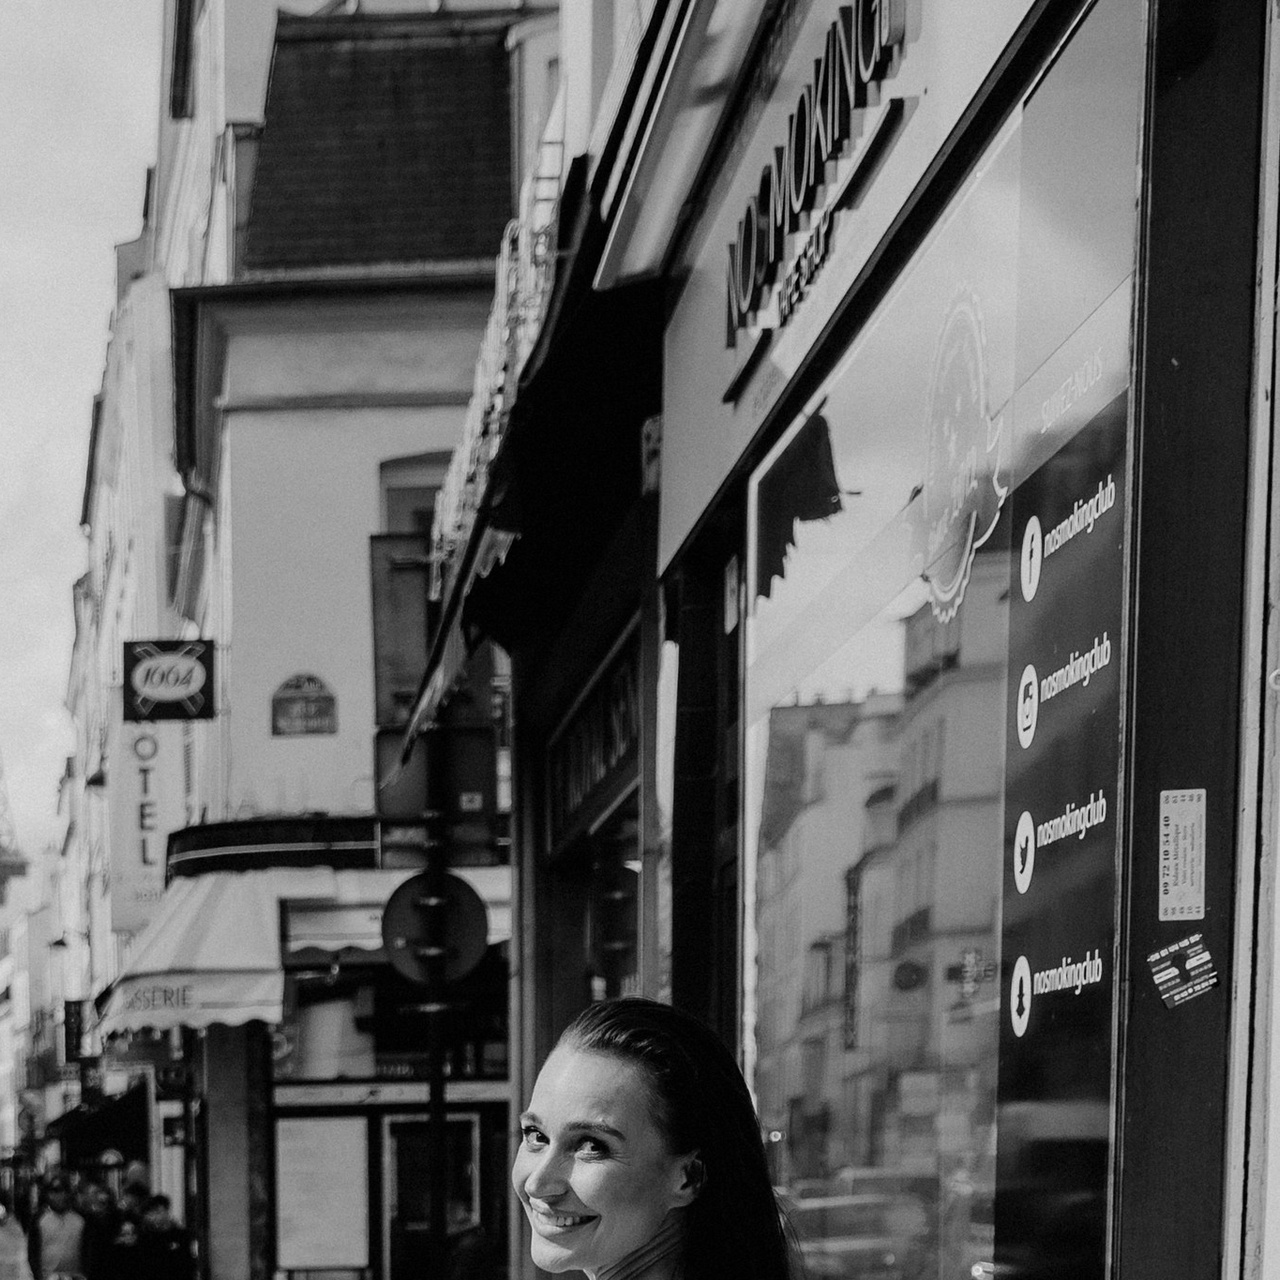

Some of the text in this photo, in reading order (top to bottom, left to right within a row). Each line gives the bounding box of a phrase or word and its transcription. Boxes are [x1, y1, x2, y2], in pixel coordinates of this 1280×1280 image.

[1044, 473, 1116, 558] nosmokingclub
[143, 665, 197, 689] 1664
[1040, 631, 1111, 703] nosmokingclub
[133, 733, 158, 866] OTEL
[1036, 788, 1107, 849] nosmokingclub
[1033, 948, 1102, 995] nosmokingclub
